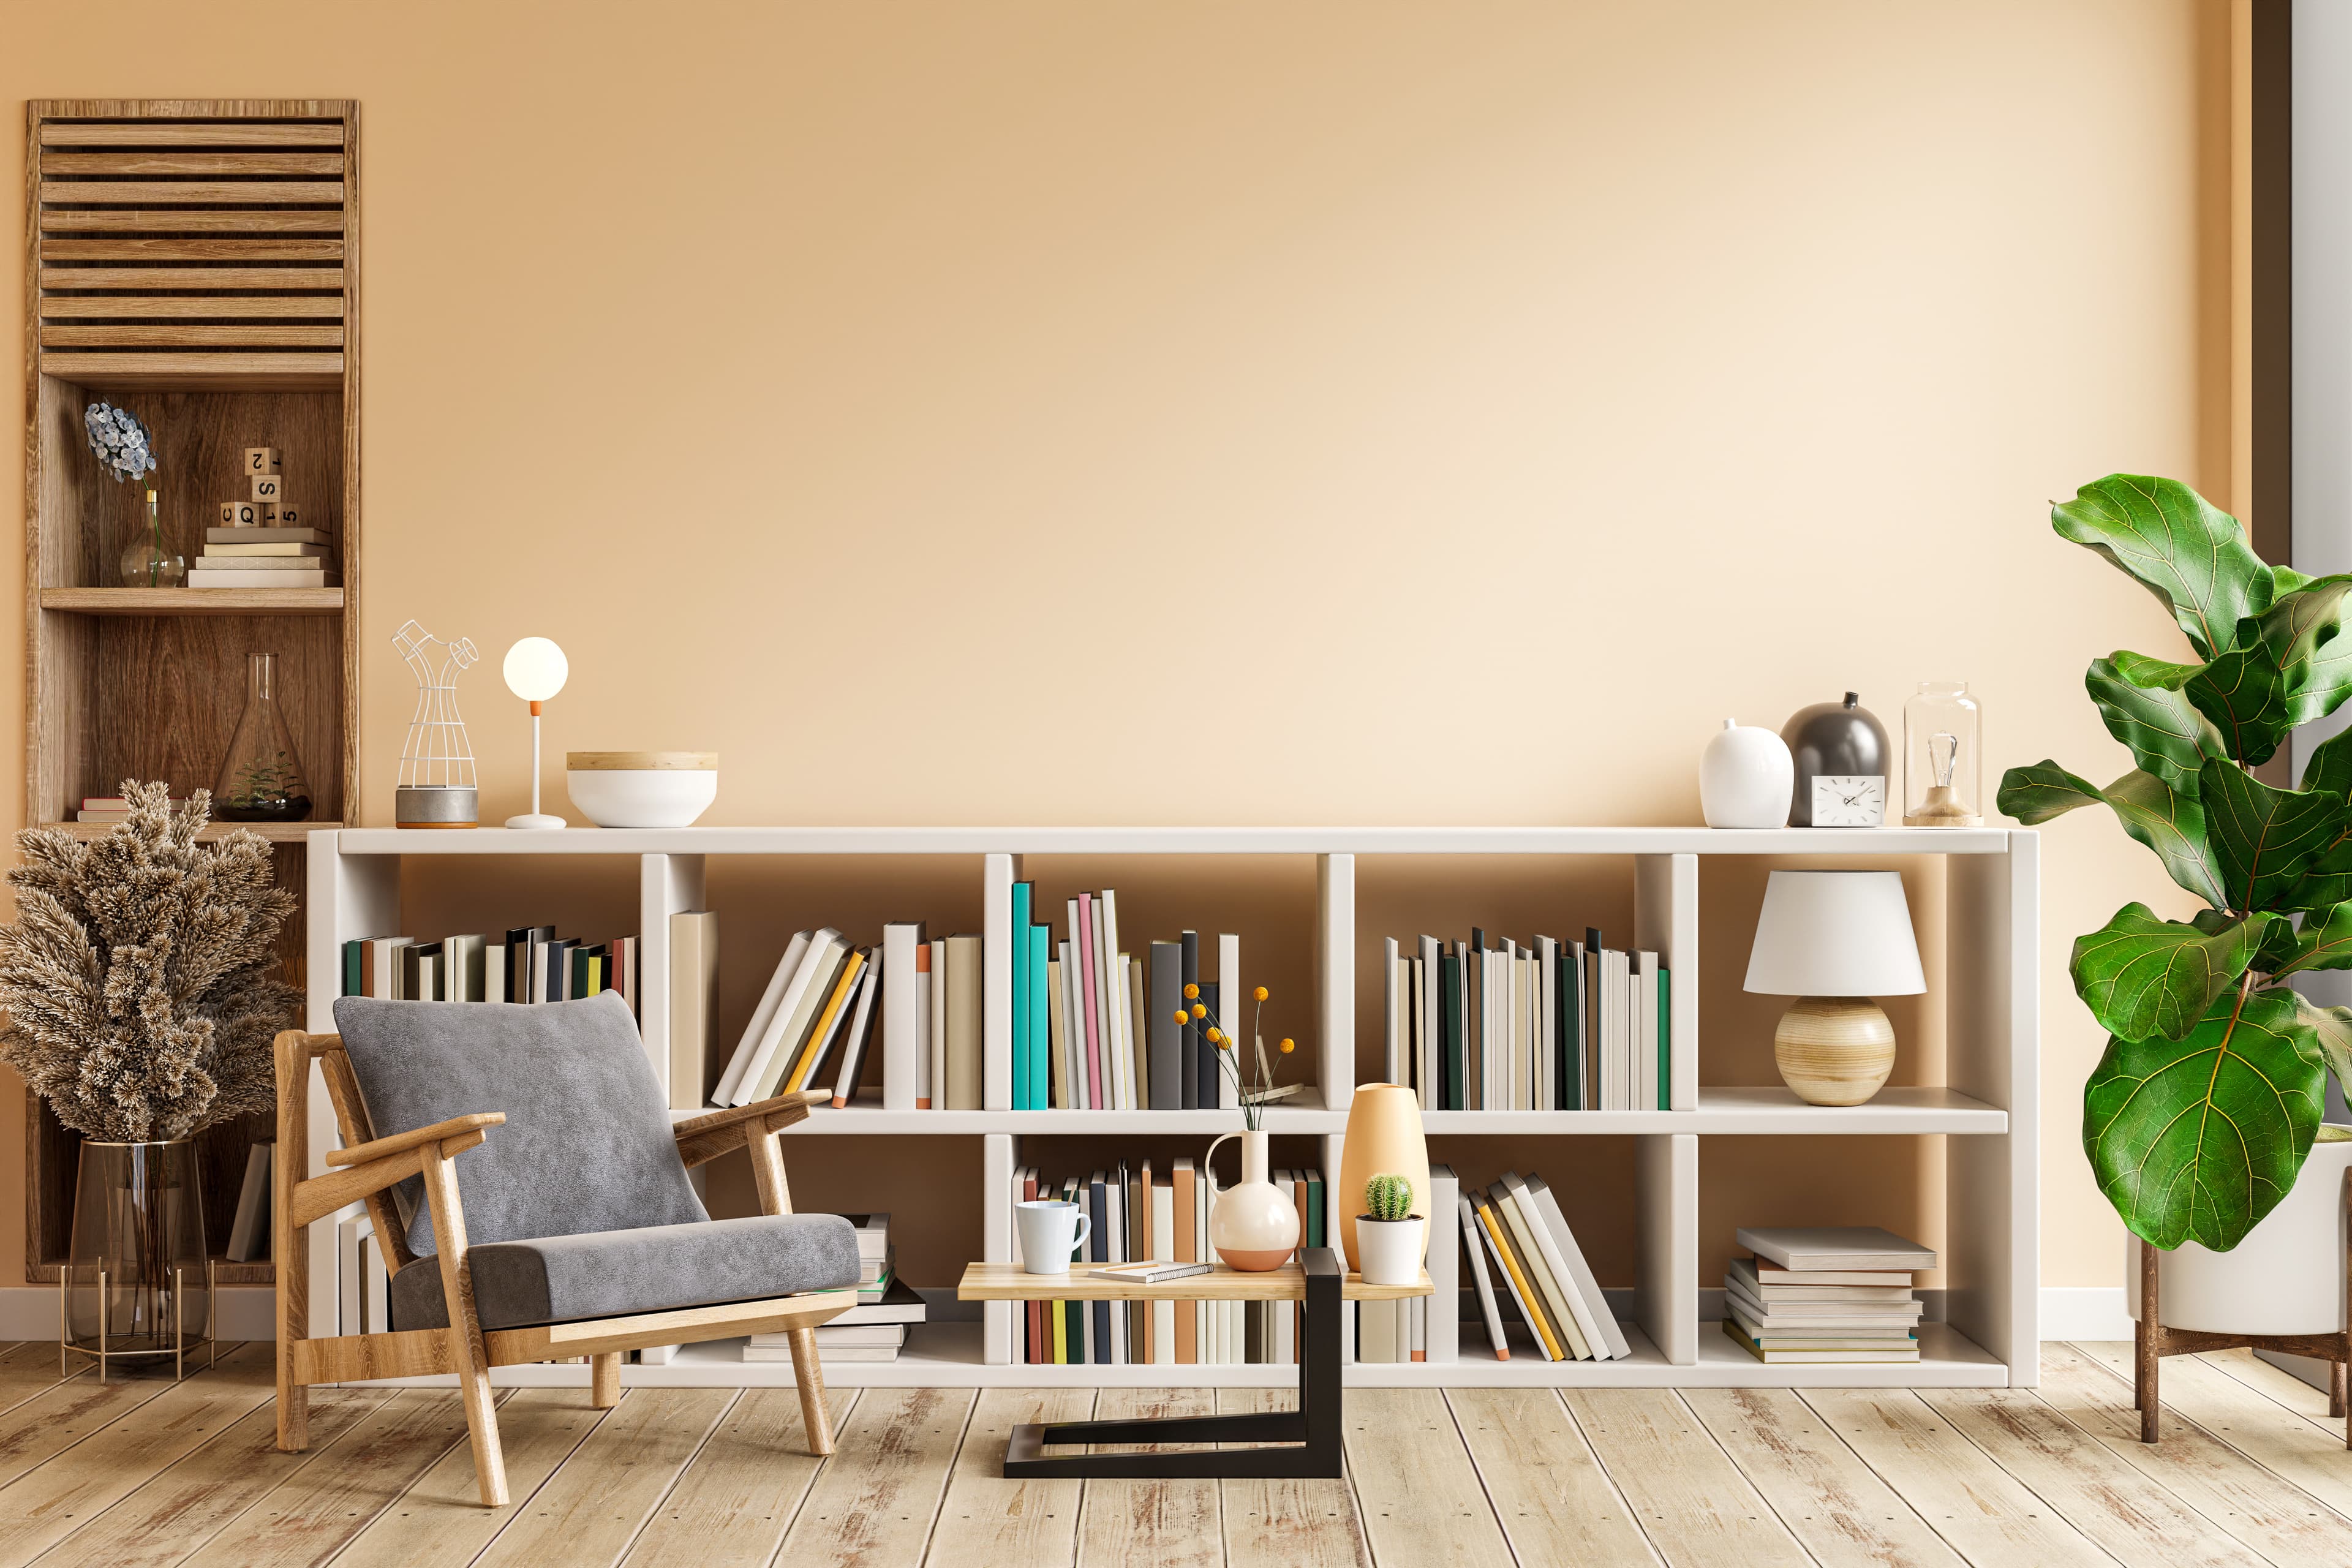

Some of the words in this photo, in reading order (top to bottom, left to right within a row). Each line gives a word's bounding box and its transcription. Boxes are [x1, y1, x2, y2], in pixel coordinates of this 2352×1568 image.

[253, 453, 262, 469] 2
[258, 482, 276, 495] S
[240, 507, 254, 524] Q
[282, 511, 297, 522] 5
